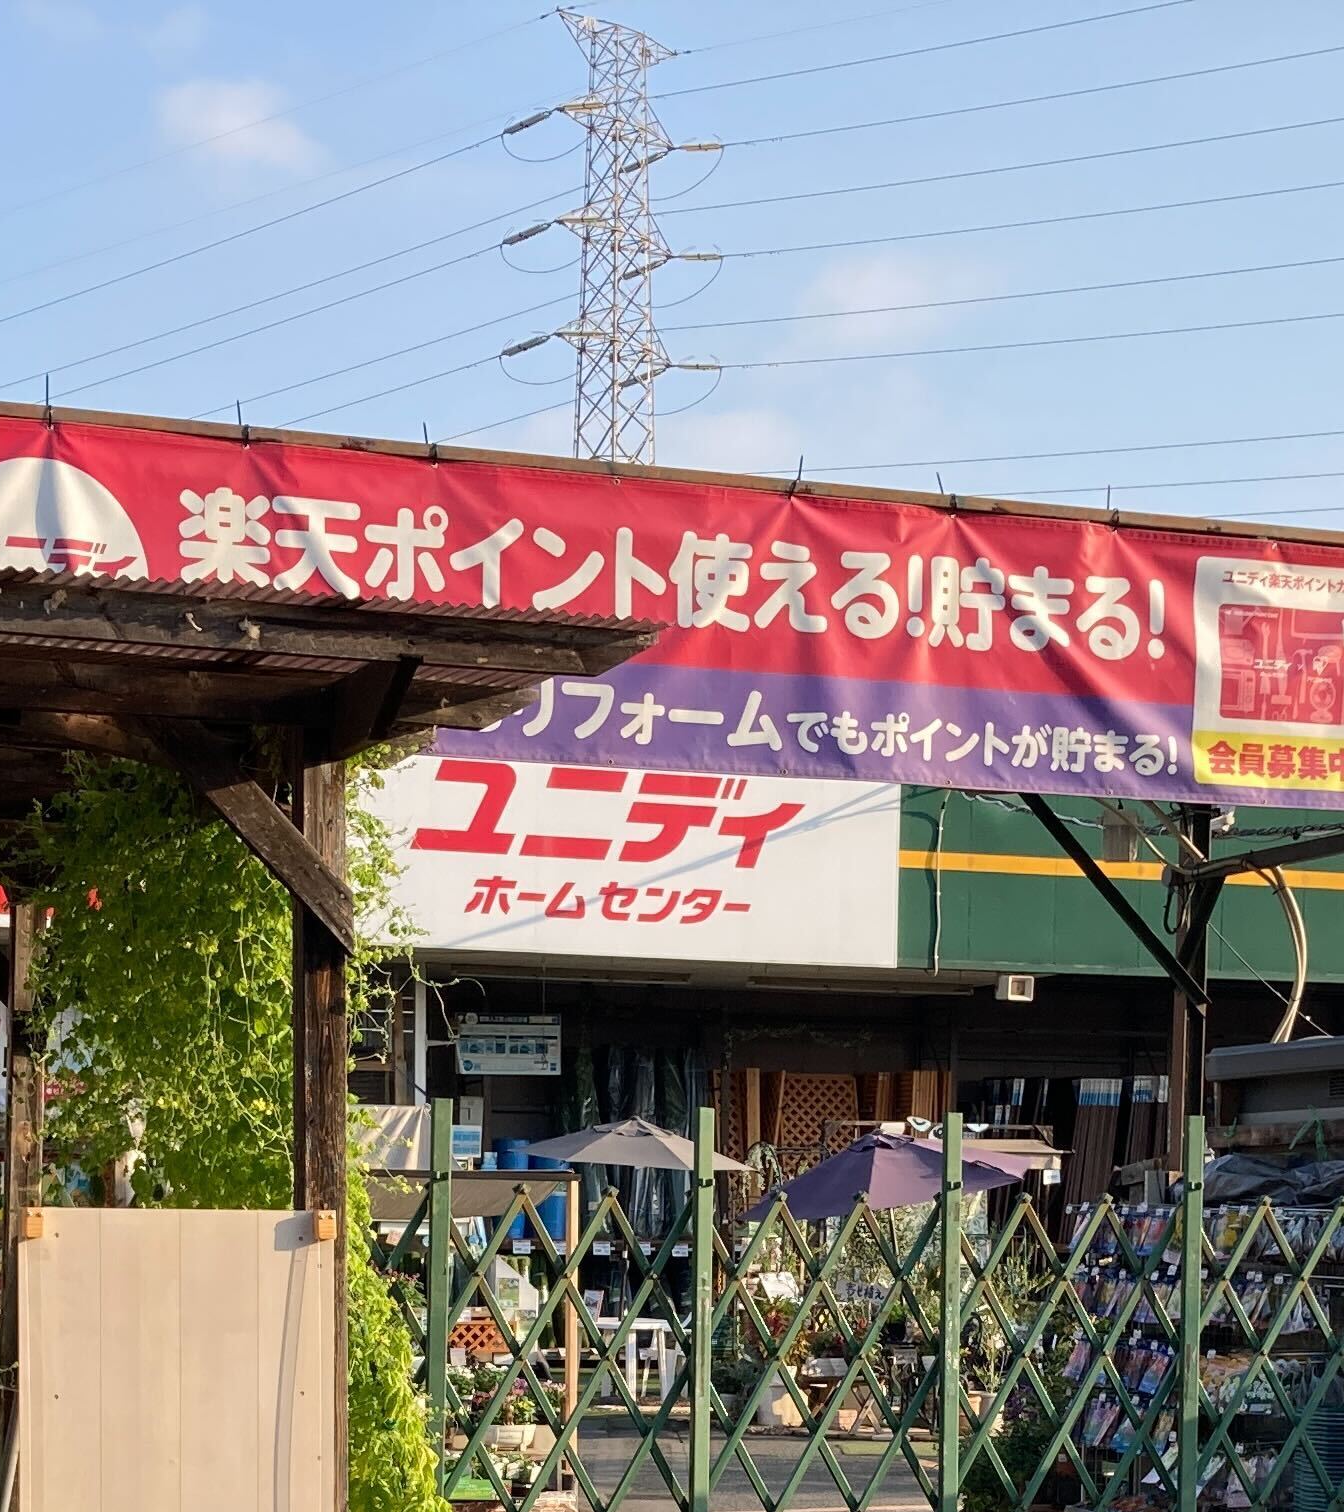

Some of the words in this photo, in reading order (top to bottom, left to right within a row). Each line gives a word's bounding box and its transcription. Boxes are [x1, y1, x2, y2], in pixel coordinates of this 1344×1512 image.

[179, 487, 1166, 660] 楽天ポイント使える!貯まる!
[479, 677, 1179, 776] リフォームでもポイントが貯まる!
[410, 759, 805, 870] ユニディ
[464, 875, 751, 925] ホームセンター
